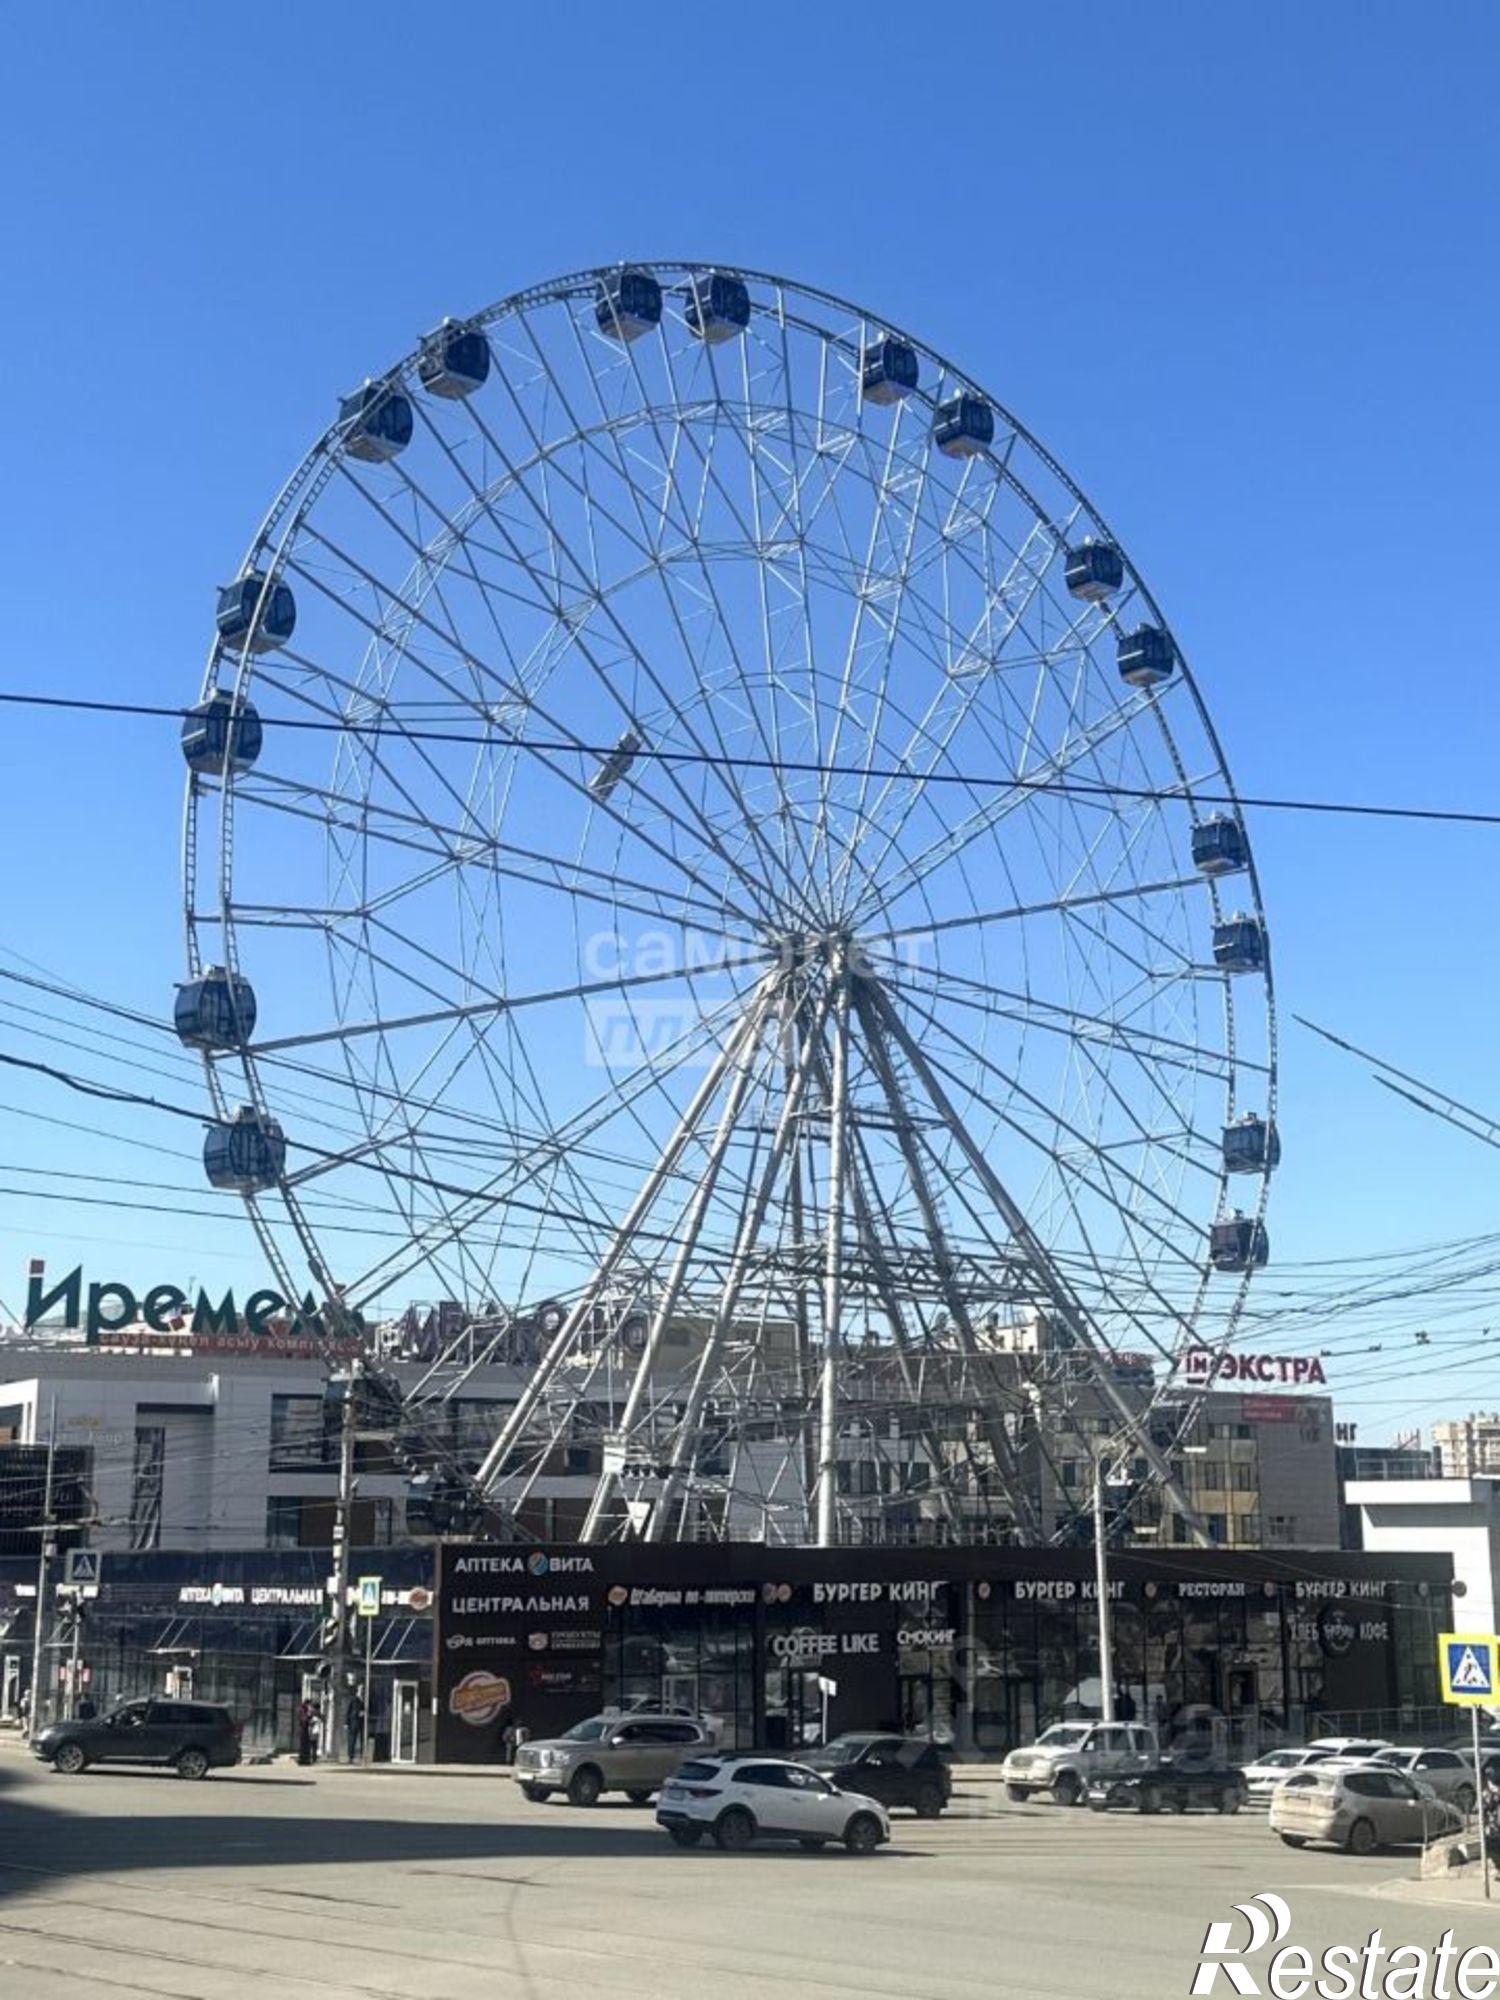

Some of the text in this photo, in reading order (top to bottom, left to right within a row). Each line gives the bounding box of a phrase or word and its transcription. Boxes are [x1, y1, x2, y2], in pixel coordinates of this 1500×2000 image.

[1221, 1353, 1327, 1384] ЭКСТРА
[454, 1556, 594, 1573] АПТЕКА ВИТА
[813, 1581, 942, 1602] БУРГЕР КИНГ
[1015, 1581, 1076, 1599] БУРГЕР
[1178, 1582, 1246, 1597] РЕСТОРАН
[1295, 1580, 1387, 1598] БУРГЕР КИНГ
[452, 1596, 590, 1615] ЦЕНТРАЛЬНАЯ
[773, 1633, 880, 1656] COFFEE LIKE
